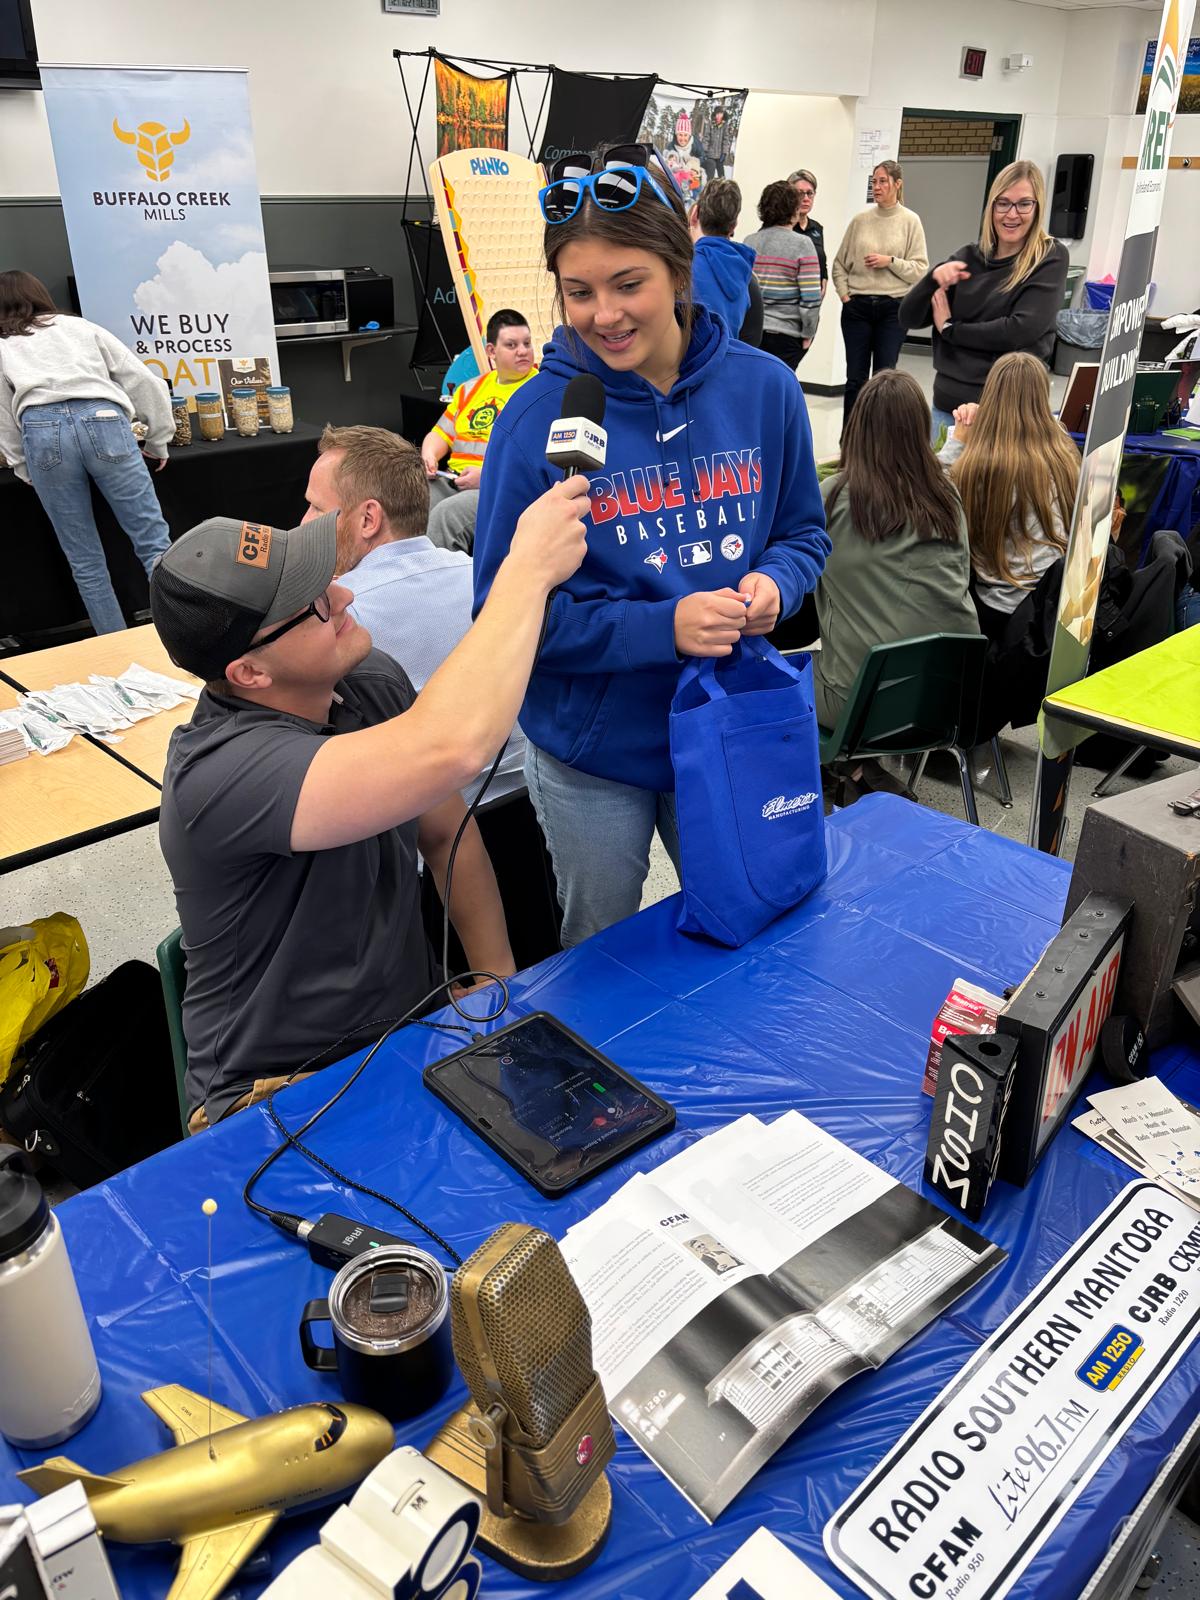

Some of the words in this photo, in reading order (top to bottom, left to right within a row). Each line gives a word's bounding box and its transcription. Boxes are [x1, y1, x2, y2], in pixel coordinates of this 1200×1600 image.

[93, 192, 171, 206] BUFFALO
[176, 192, 231, 206] CREEK
[144, 208, 186, 221] MILLS
[130, 314, 171, 335] WE
[179, 313, 229, 334] BUY
[136, 340, 149, 354] &
[154, 339, 232, 354] PROCESS
[584, 430, 605, 448] CJRB
[588, 462, 686, 525] BLUE
[692, 447, 763, 503] JAYS
[768, 804, 811, 821] MANUFACTURING
[1077, 951, 1122, 1072] AIR
[1168, 1221, 1200, 1273] CKM
[1128, 1272, 1178, 1324] CJRB
[1158, 1306, 1177, 1327] Radio
[1173, 1289, 1190, 1308] 1220
[1086, 1362, 1112, 1386] AM
[1102, 1331, 1133, 1363] 1250
[1117, 1357, 1136, 1379] RADIO
[868, 1450, 966, 1554] RADIO
[953, 1313, 1083, 1452] SOUTHERN
[1064, 1207, 1174, 1320] MANITOBA
[909, 1516, 983, 1600] CFAM
[945, 1573, 971, 1600] Radio
[967, 1552, 985, 1573] 950
